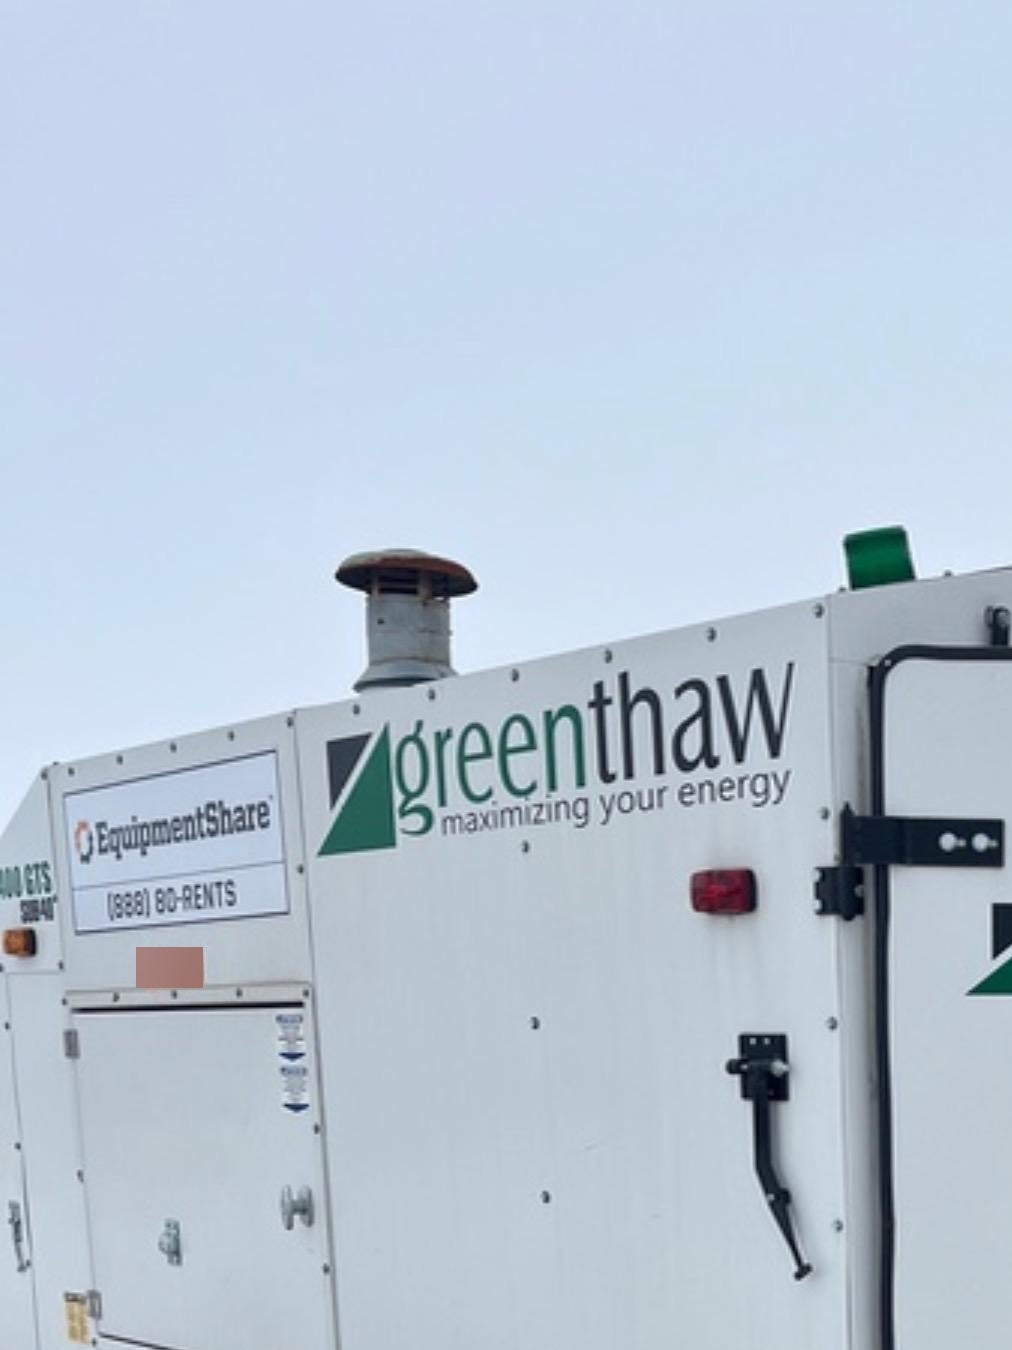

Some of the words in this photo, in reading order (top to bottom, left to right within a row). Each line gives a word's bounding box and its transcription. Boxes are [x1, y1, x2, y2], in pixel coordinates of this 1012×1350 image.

[395, 662, 795, 836] greenthaw
[95, 800, 272, 860] EquipmentShare
[441, 793, 590, 836] maximizing
[599, 786, 667, 826] your
[677, 768, 792, 807] energy
[107, 886, 150, 921] (888)
[155, 880, 238, 915] 80-RENTS
